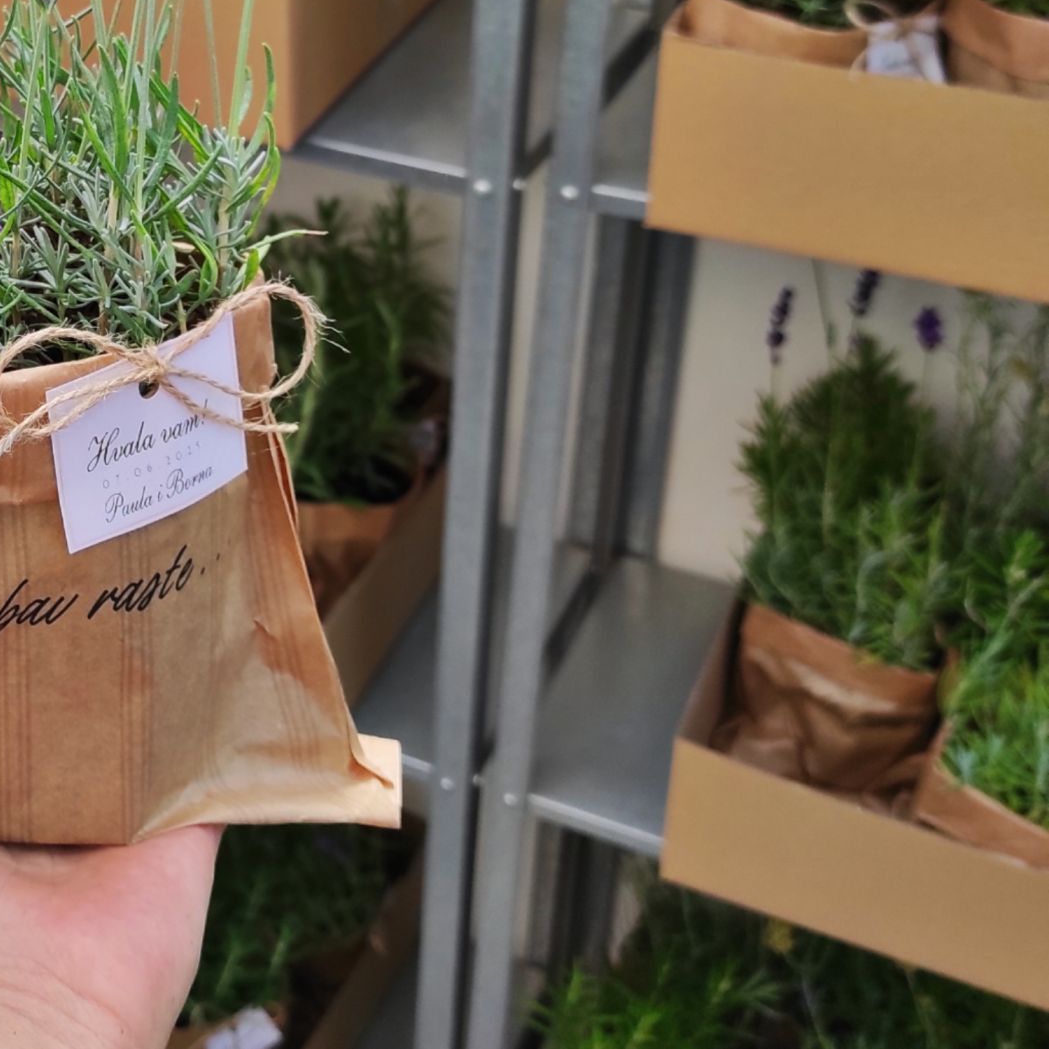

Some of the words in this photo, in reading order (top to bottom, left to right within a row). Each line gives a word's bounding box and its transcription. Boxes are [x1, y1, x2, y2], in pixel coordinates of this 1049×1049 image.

[86, 421, 154, 473] Hvala
[105, 486, 153, 524] Paula
[157, 483, 165, 502] i
[166, 466, 214, 500] Borna
